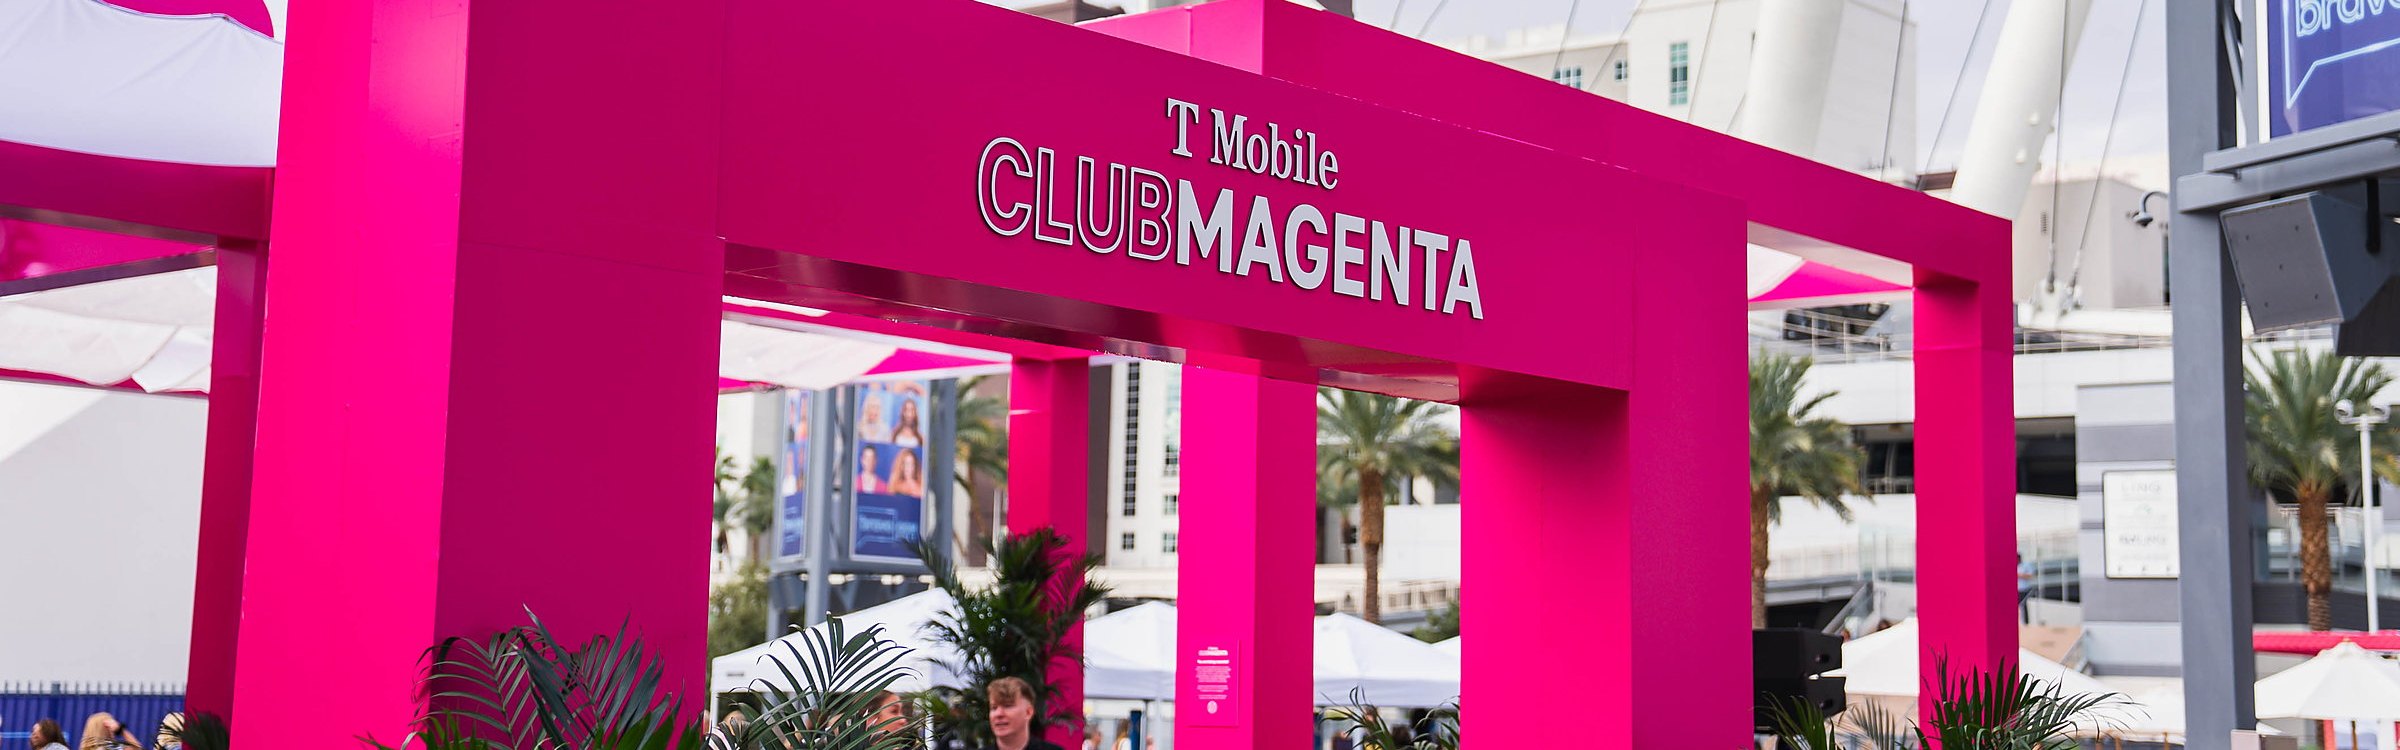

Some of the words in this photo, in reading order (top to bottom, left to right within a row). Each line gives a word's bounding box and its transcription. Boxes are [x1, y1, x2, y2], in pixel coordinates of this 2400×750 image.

[2295, 0, 2400, 37] brav
[1167, 97, 1199, 158] T
[1210, 108, 1339, 190] Mobile
